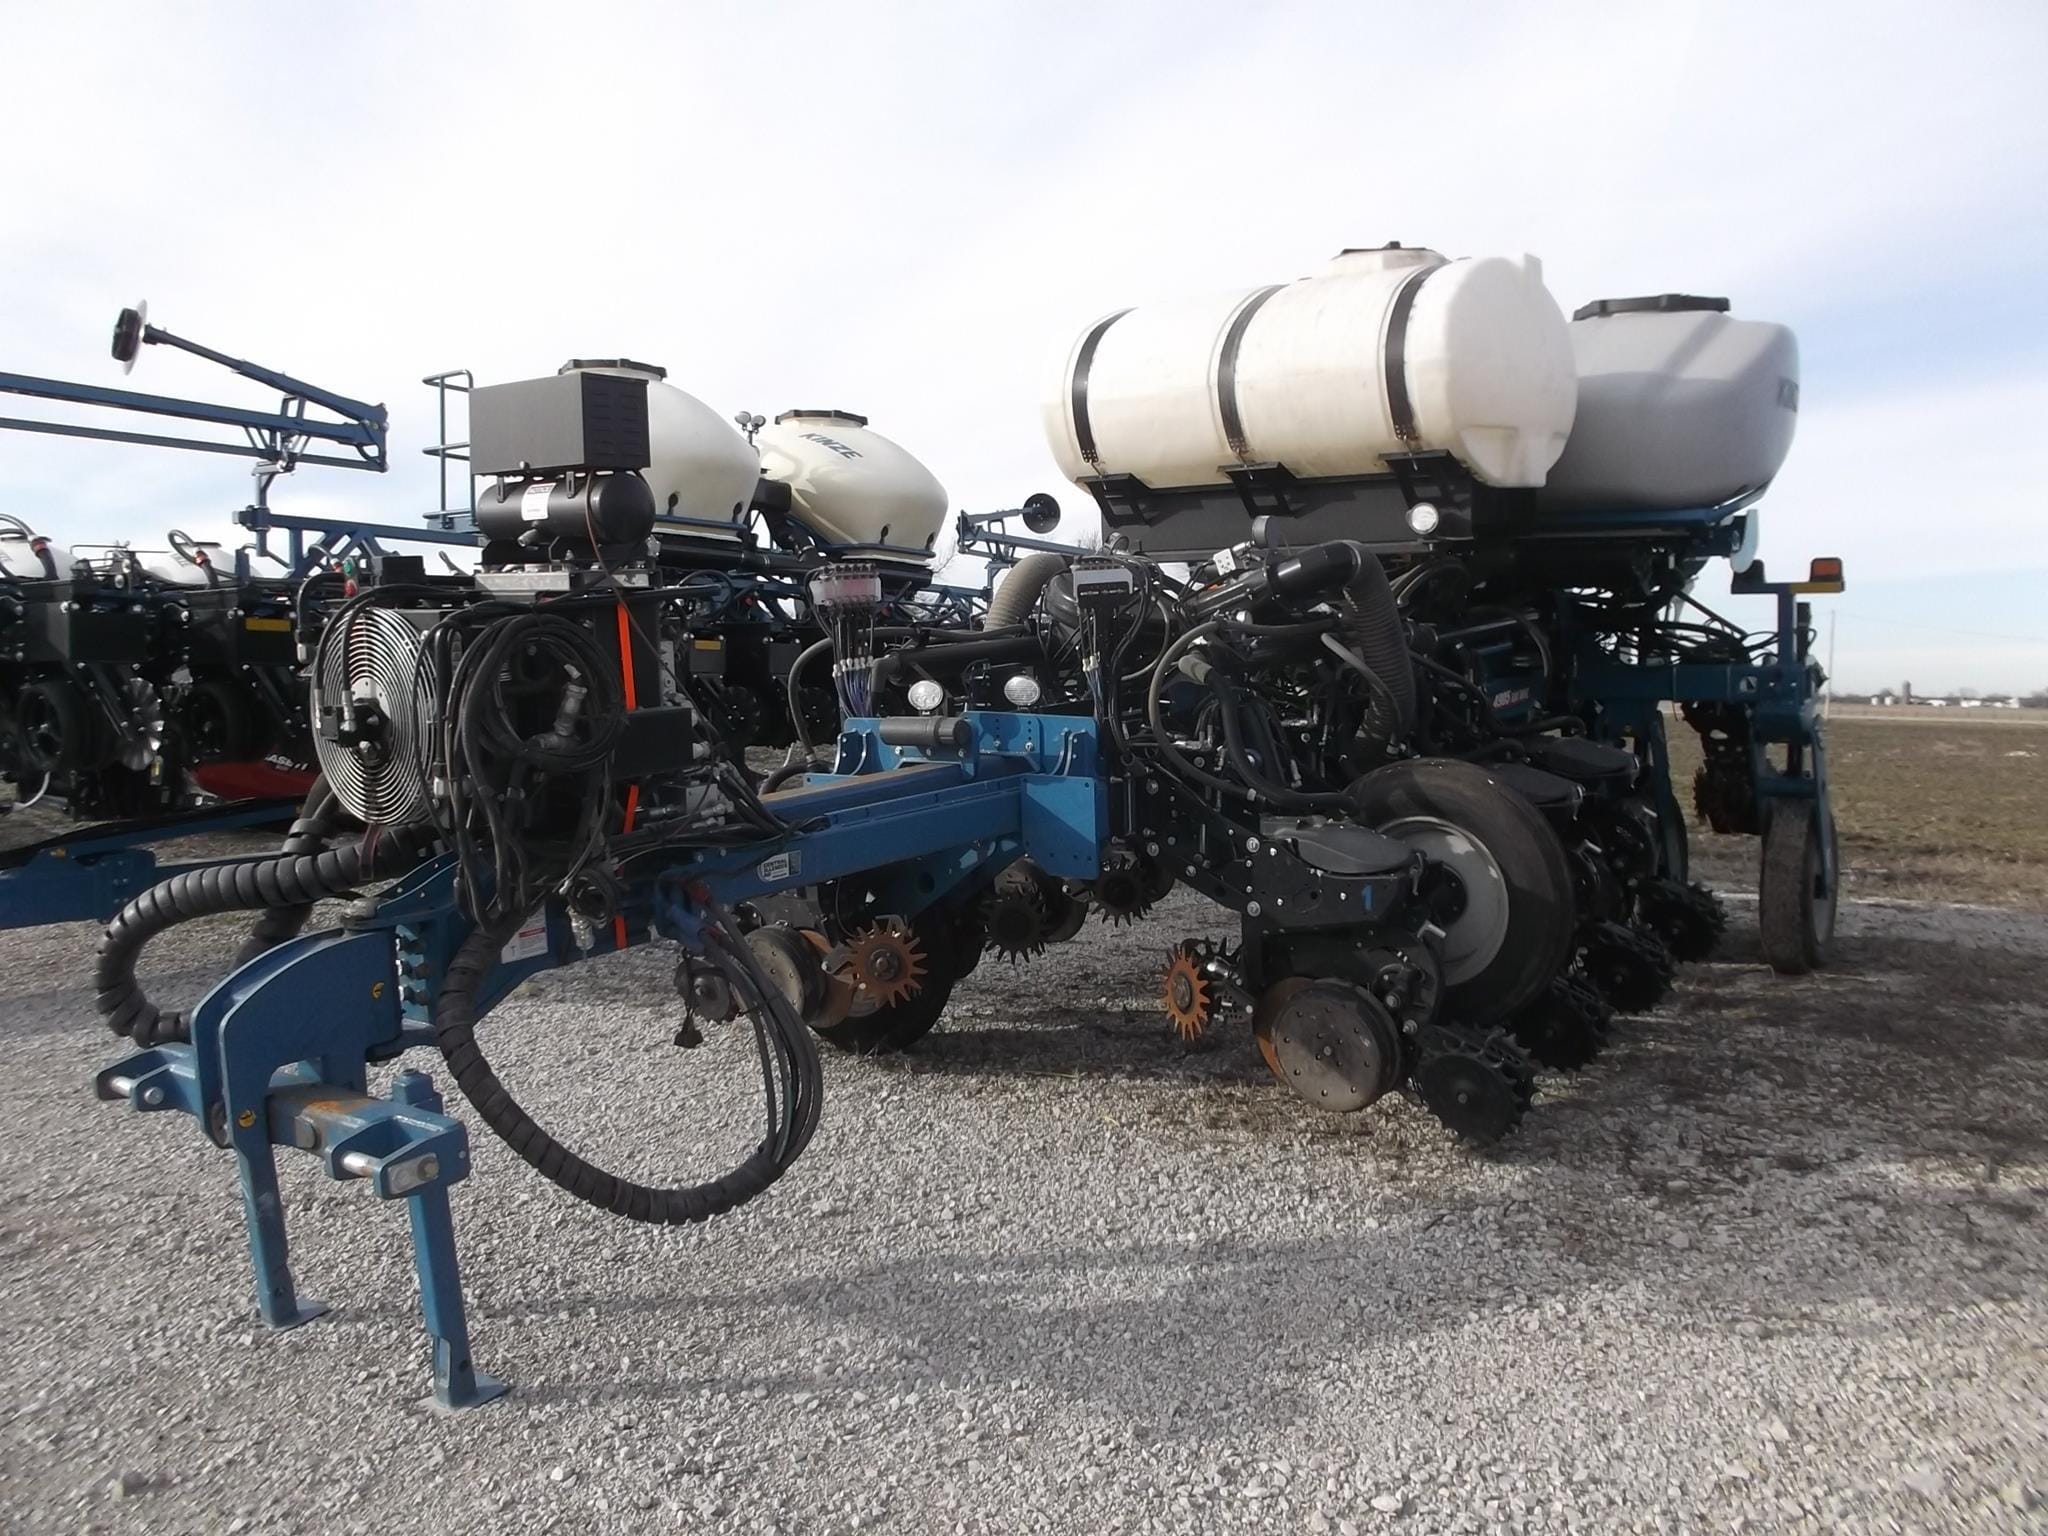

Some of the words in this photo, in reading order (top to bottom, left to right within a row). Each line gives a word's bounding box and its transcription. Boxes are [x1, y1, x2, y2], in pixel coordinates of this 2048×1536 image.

[798, 433, 863, 460] KINZE
[264, 754, 294, 767] ASE
[1361, 885, 1372, 910] 1
